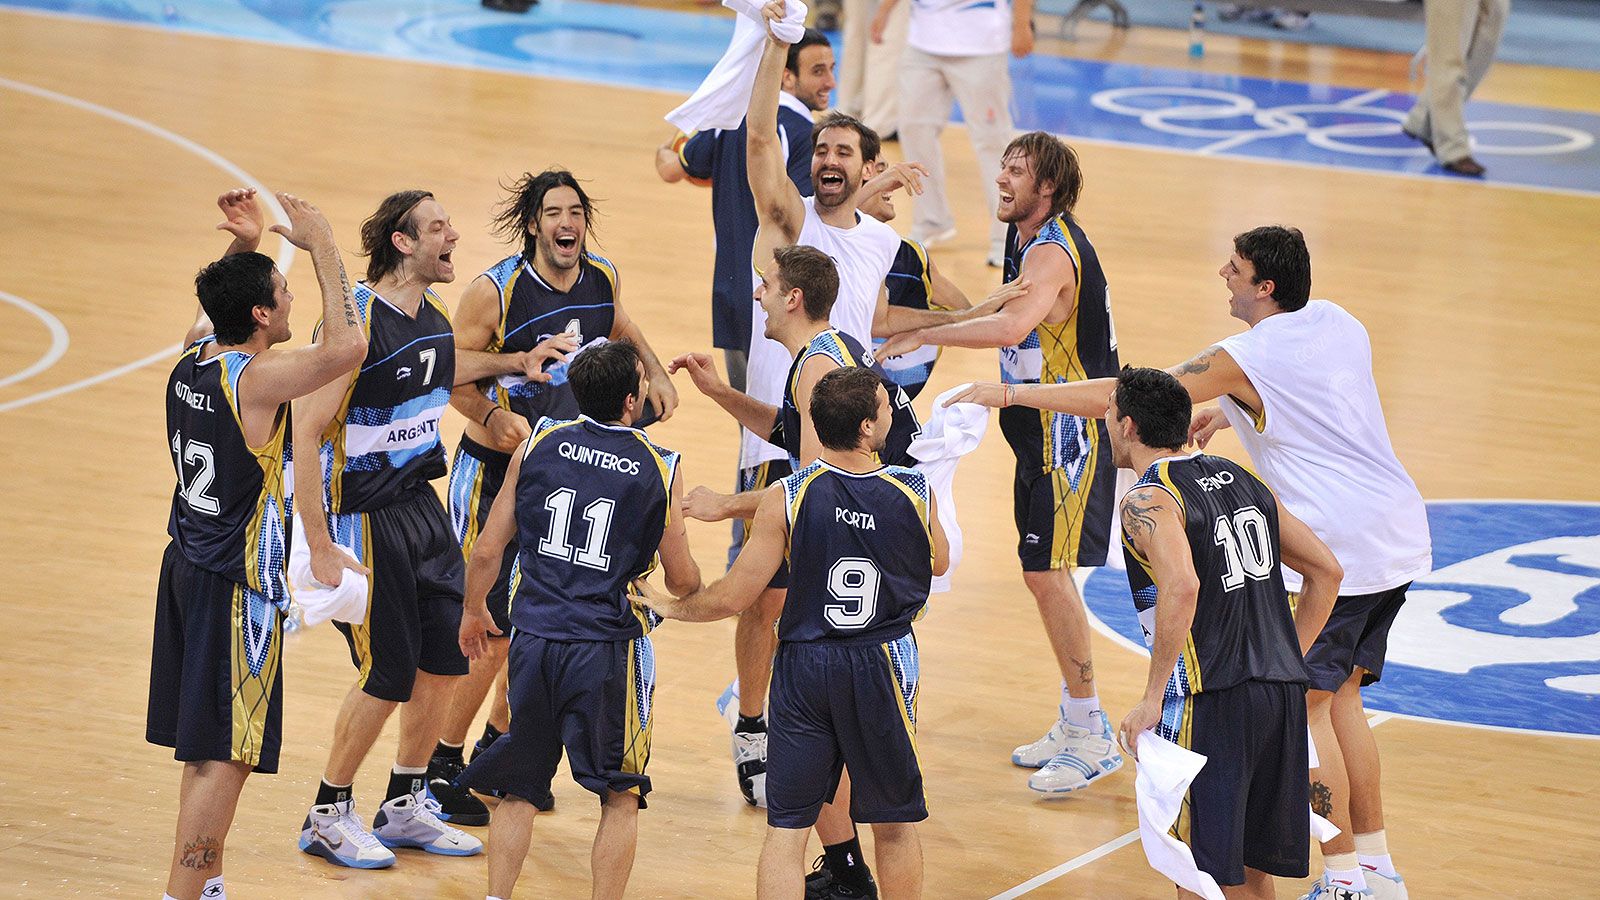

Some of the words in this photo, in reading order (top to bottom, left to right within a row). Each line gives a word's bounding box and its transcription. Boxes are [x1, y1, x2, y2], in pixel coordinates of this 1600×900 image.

[565, 318, 584, 348] 4
[419, 347, 437, 386] 7
[172, 429, 221, 516] 12
[558, 441, 641, 476] QUINTEROS
[537, 486, 616, 572] 11
[835, 506, 876, 531] PORTA
[1213, 505, 1275, 593] 10
[823, 557, 881, 629] 9
